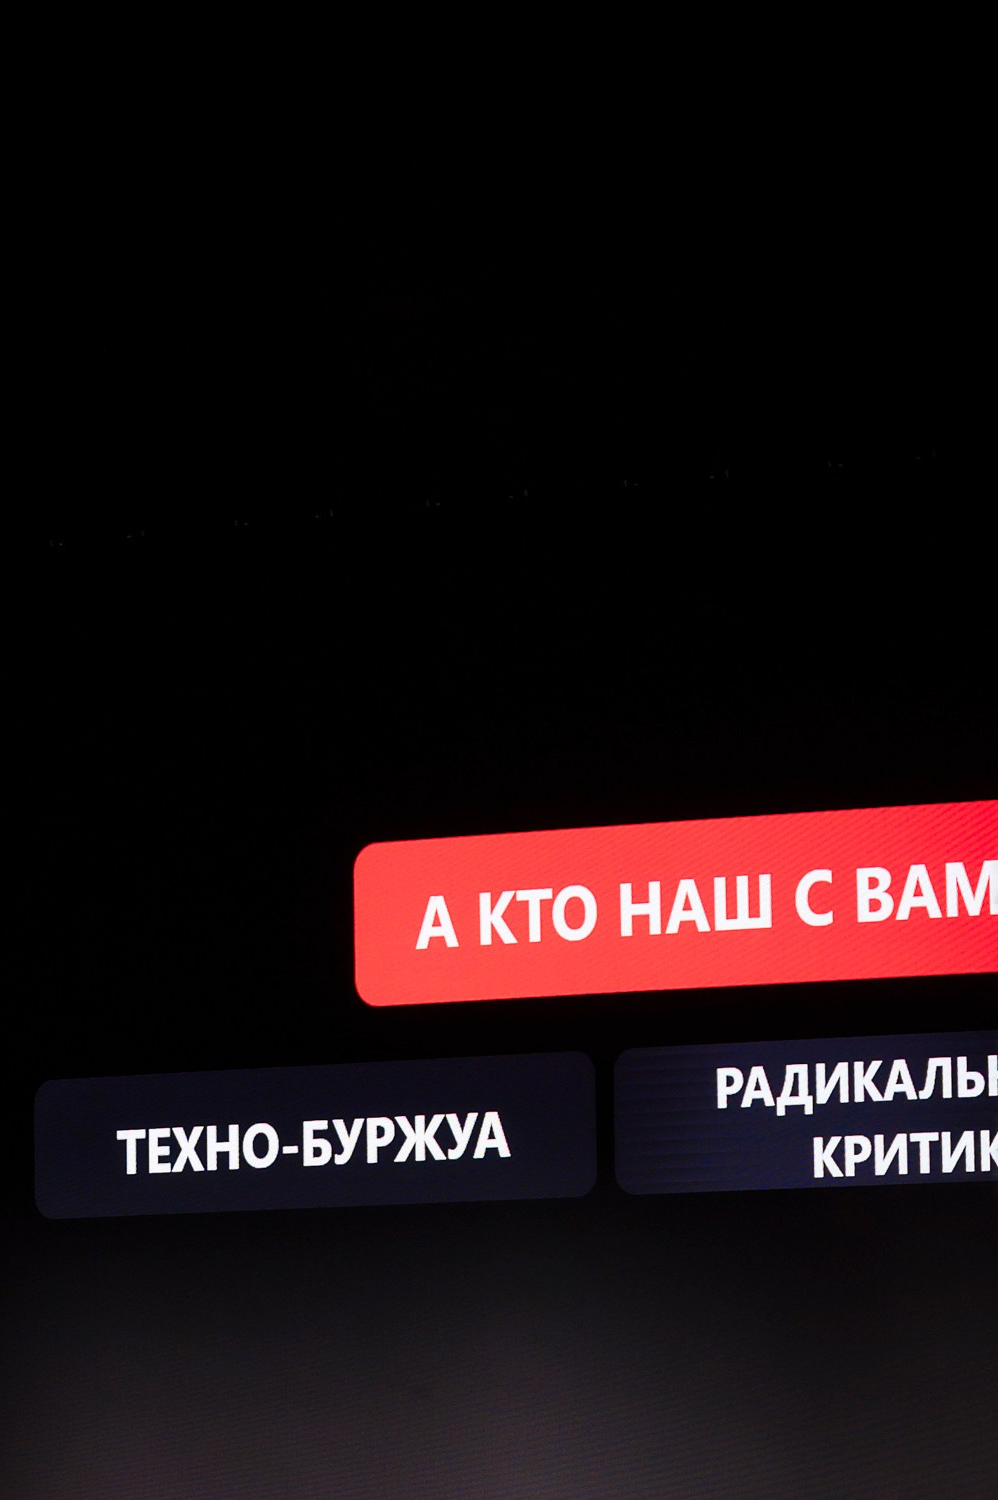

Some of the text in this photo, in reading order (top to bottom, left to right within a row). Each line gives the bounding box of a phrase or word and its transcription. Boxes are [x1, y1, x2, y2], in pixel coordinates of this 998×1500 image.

[416, 895, 458, 950] А
[478, 885, 598, 946] КТО
[620, 873, 772, 937] НАШ
[794, 869, 834, 927] С
[116, 1111, 512, 1176] ТЕХНО-БУРЖУА
